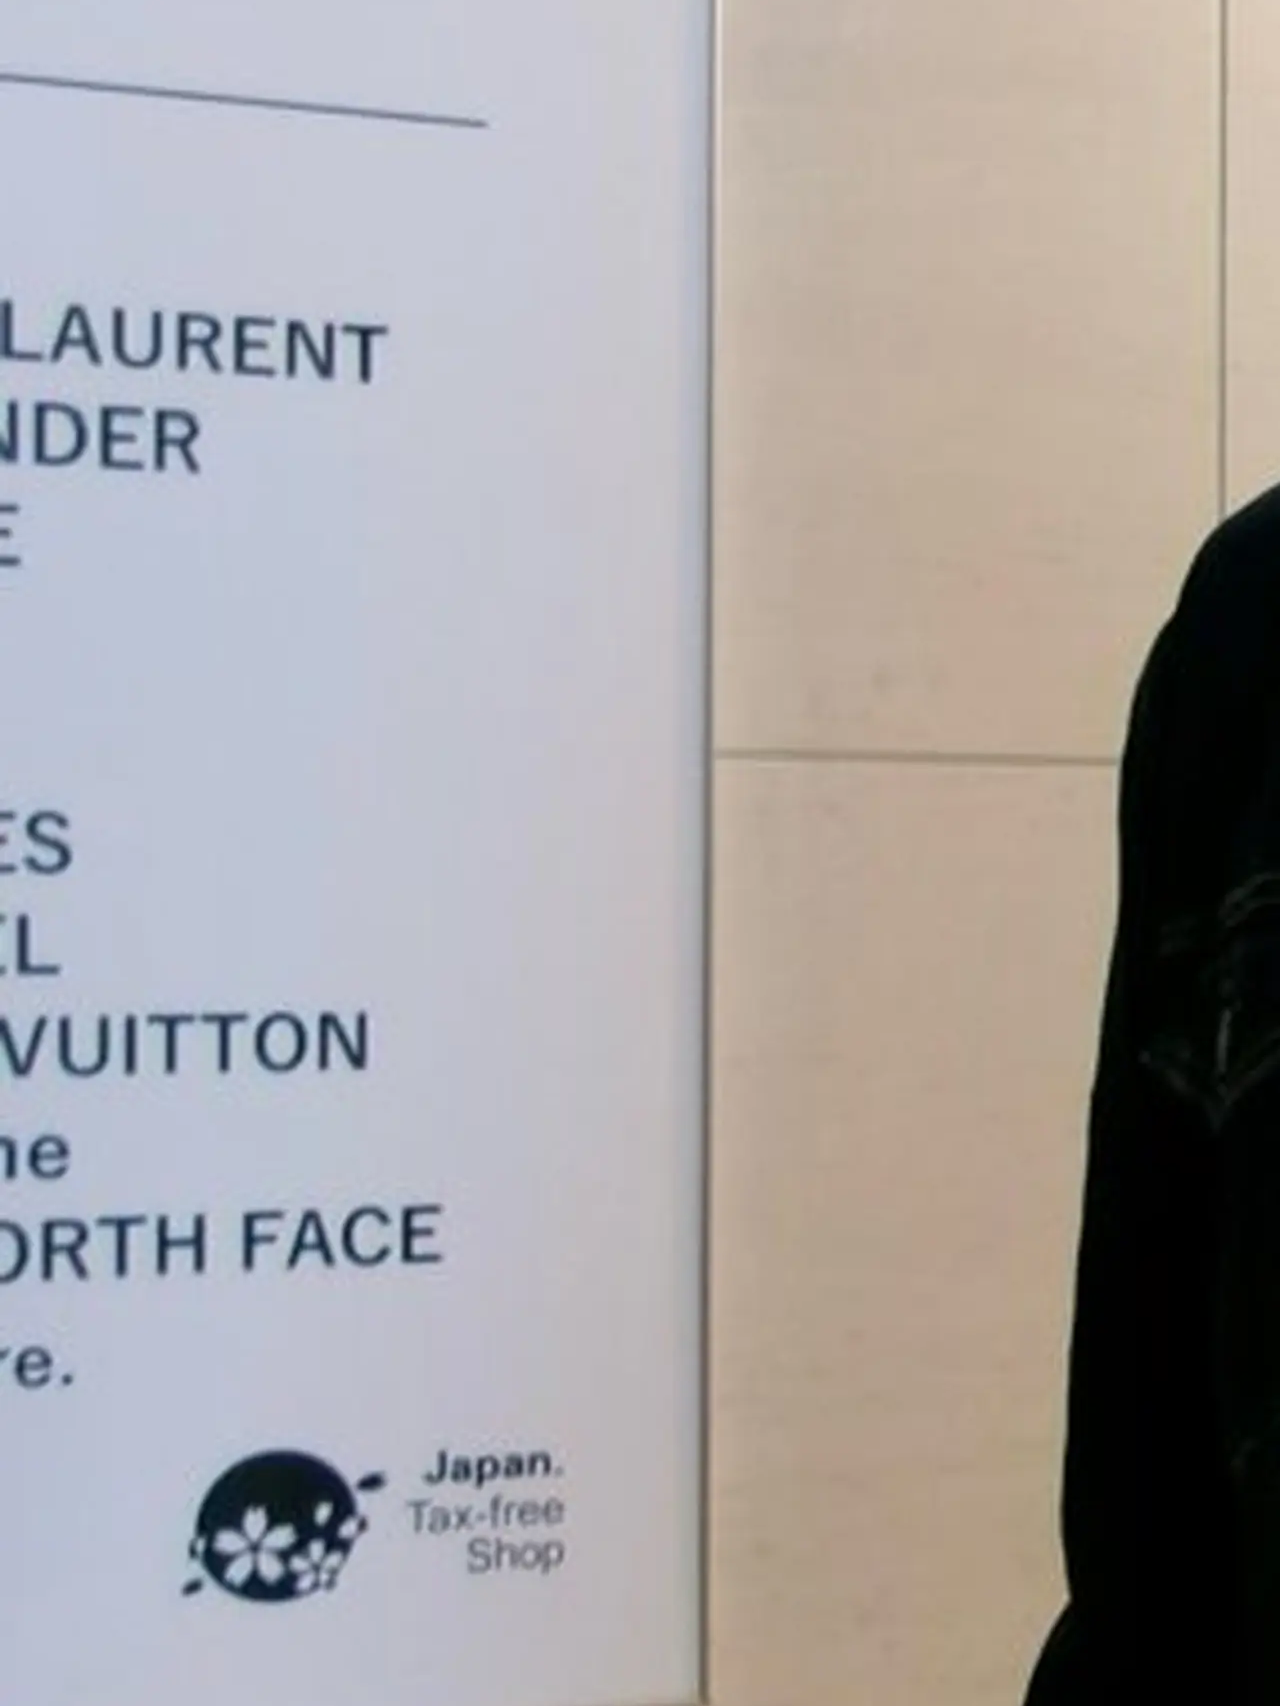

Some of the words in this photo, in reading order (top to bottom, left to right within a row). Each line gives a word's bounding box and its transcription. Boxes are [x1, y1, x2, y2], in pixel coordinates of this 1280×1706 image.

[0, 296, 390, 386] LAURENT
[0, 911, 63, 979] L
[0, 1008, 370, 1082] VUITTON
[240, 1201, 445, 1274] FACE
[421, 1448, 565, 1490] Japan.
[407, 1494, 566, 1536] Tax-free
[466, 1536, 566, 1575] Shop
